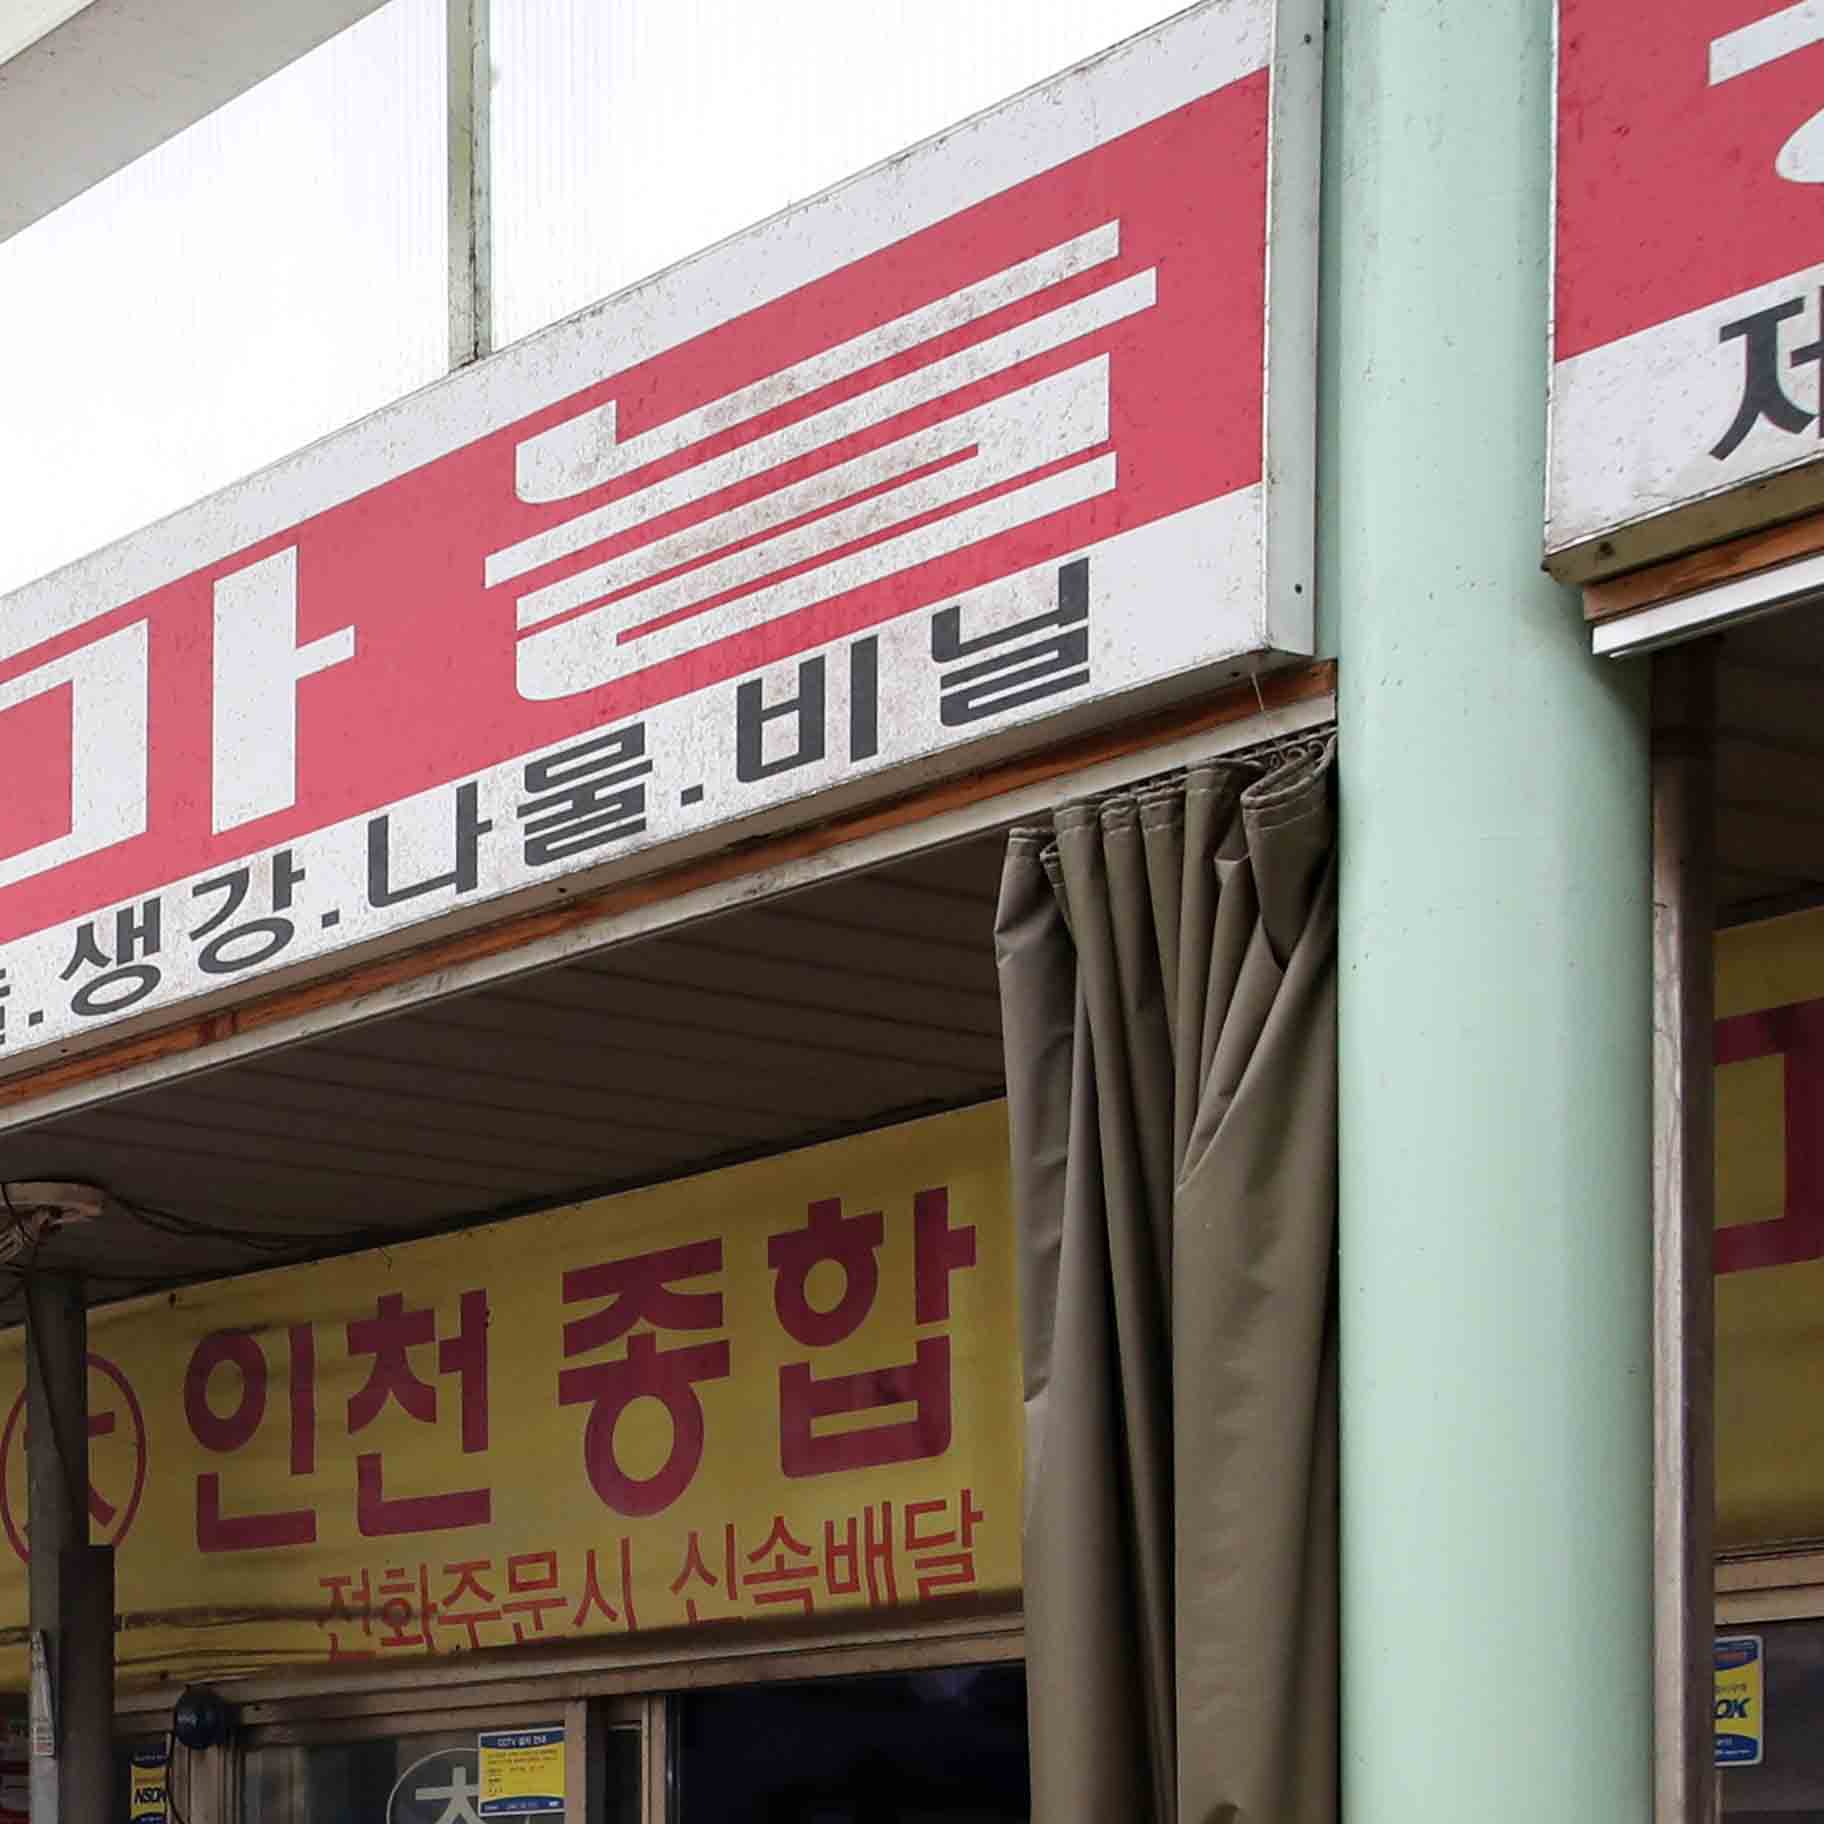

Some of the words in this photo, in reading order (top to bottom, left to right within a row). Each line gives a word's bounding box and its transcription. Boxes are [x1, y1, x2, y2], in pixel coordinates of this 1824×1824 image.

[183, 1285, 491, 1554] 인천
[558, 1187, 977, 1518] 종합
[317, 1537, 638, 1661] 전화주문시
[670, 1490, 984, 1630] 신속배달
